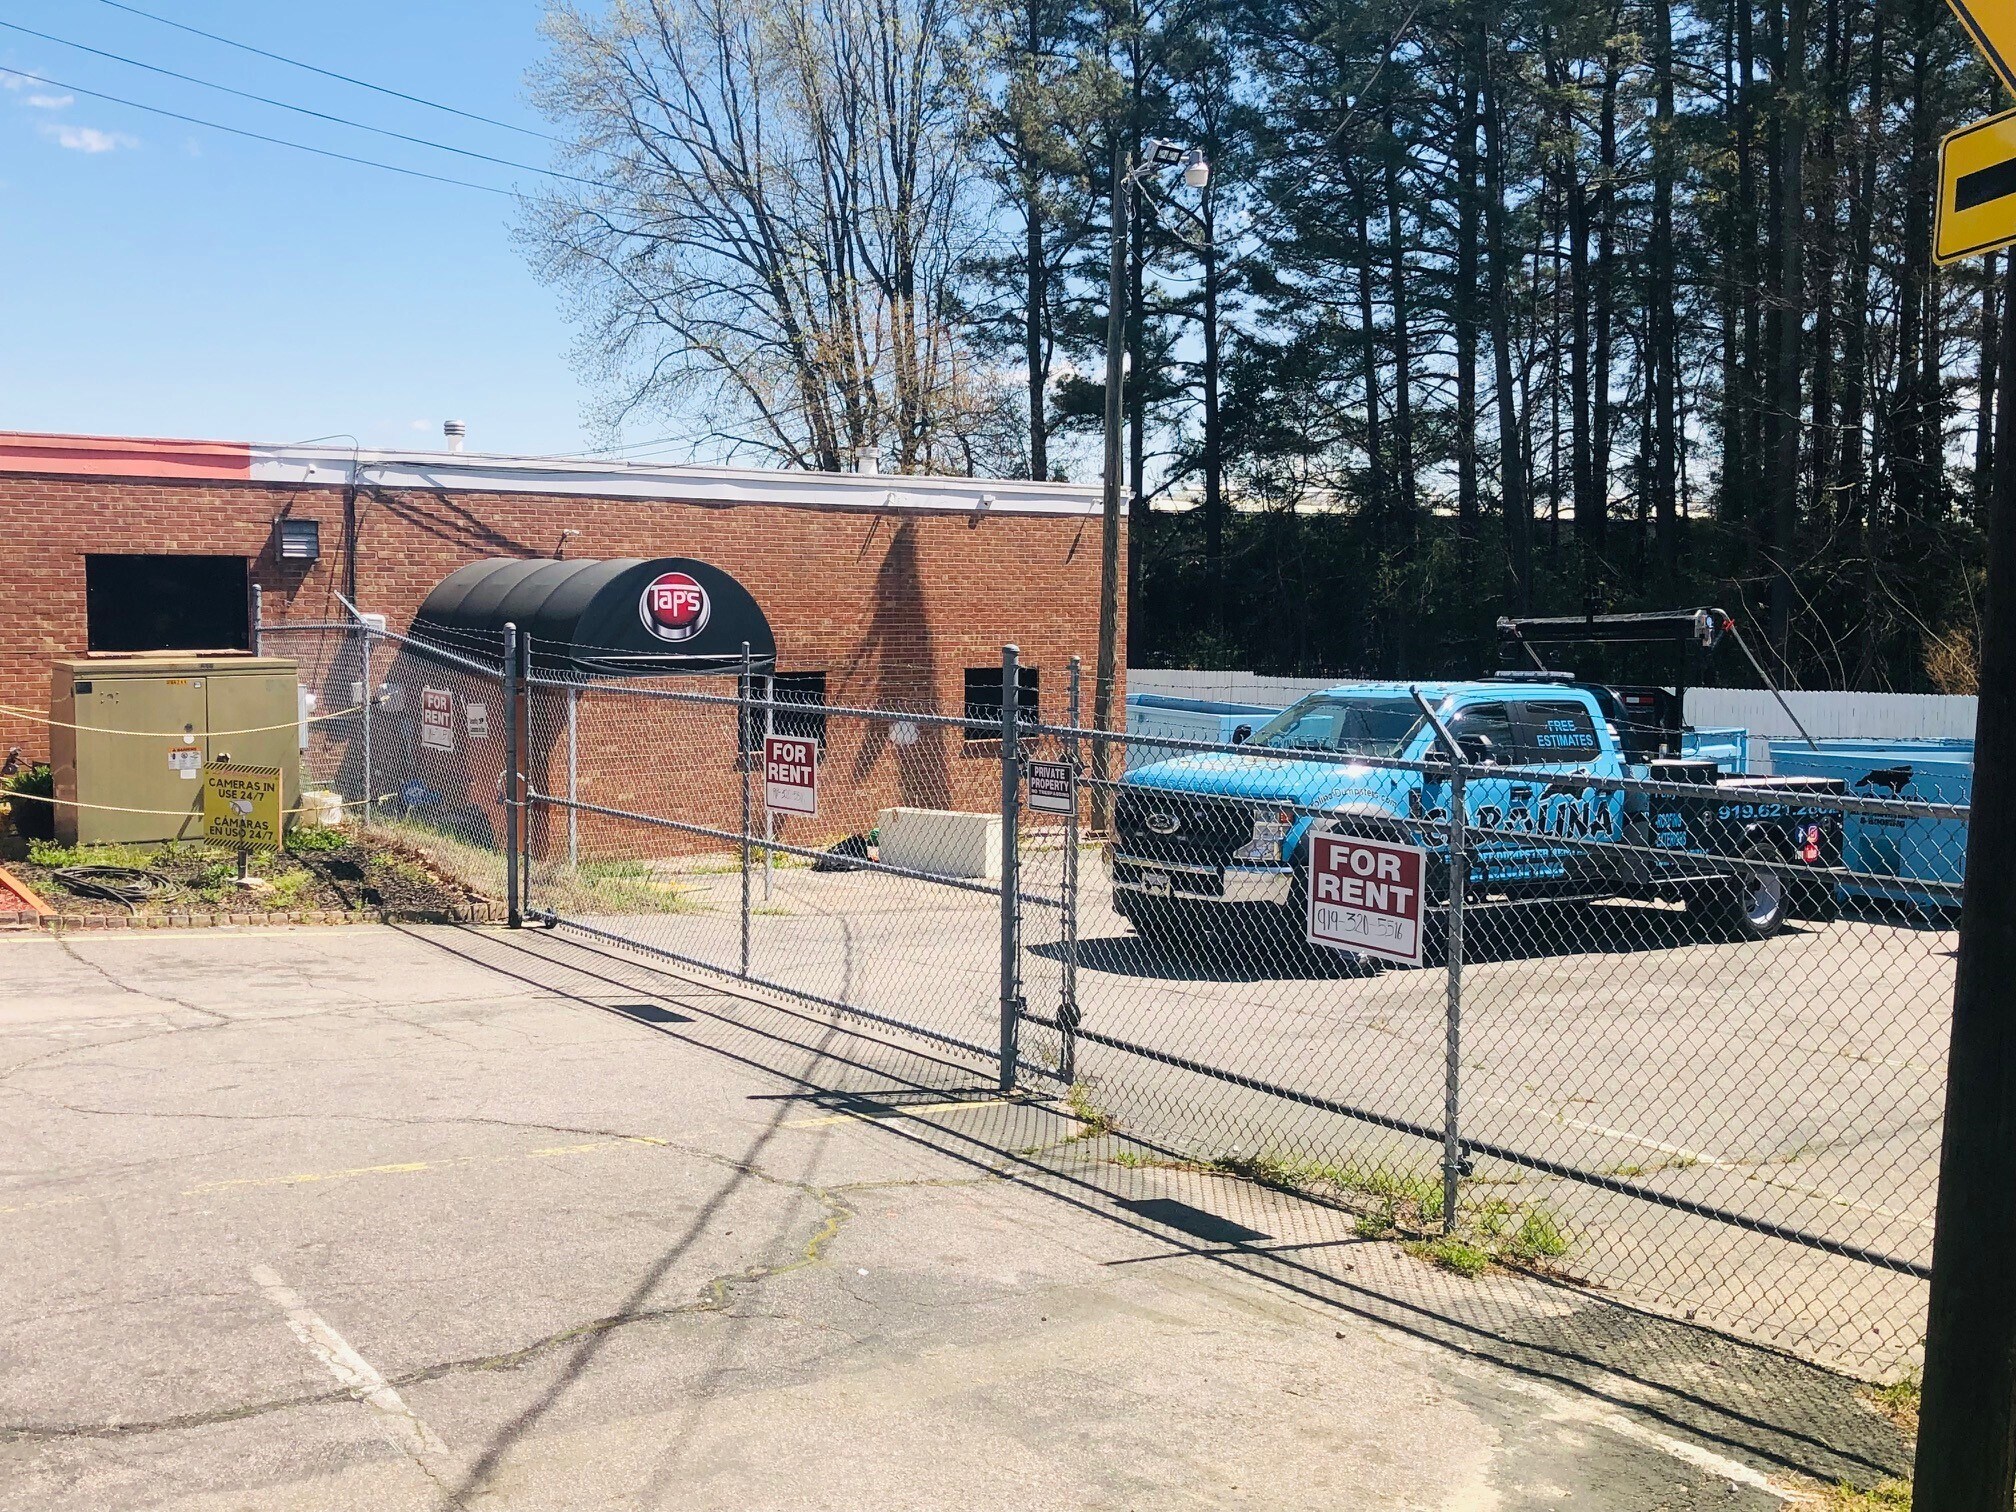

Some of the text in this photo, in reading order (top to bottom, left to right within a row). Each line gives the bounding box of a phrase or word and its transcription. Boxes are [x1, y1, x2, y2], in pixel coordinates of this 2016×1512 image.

[427, 694, 447, 711] FOR
[424, 709, 450, 727] RENT
[1547, 720, 1577, 732] FREE
[1536, 734, 1594, 747] ESTIMATES
[773, 742, 806, 764] FOR
[768, 762, 812, 785] RENT
[1034, 766, 1066, 780] PRIVATE
[208, 778, 275, 792] CAMERAS IN
[1031, 777, 1069, 792] PROPERTY
[218, 789, 265, 802] USE 24/7
[214, 815, 269, 830] CÁMARAS
[209, 826, 273, 840] EN USO 24/7
[1329, 844, 1401, 882] FOR
[1317, 872, 1414, 914] RENT
[1317, 908, 1403, 940] 919-320-5516
